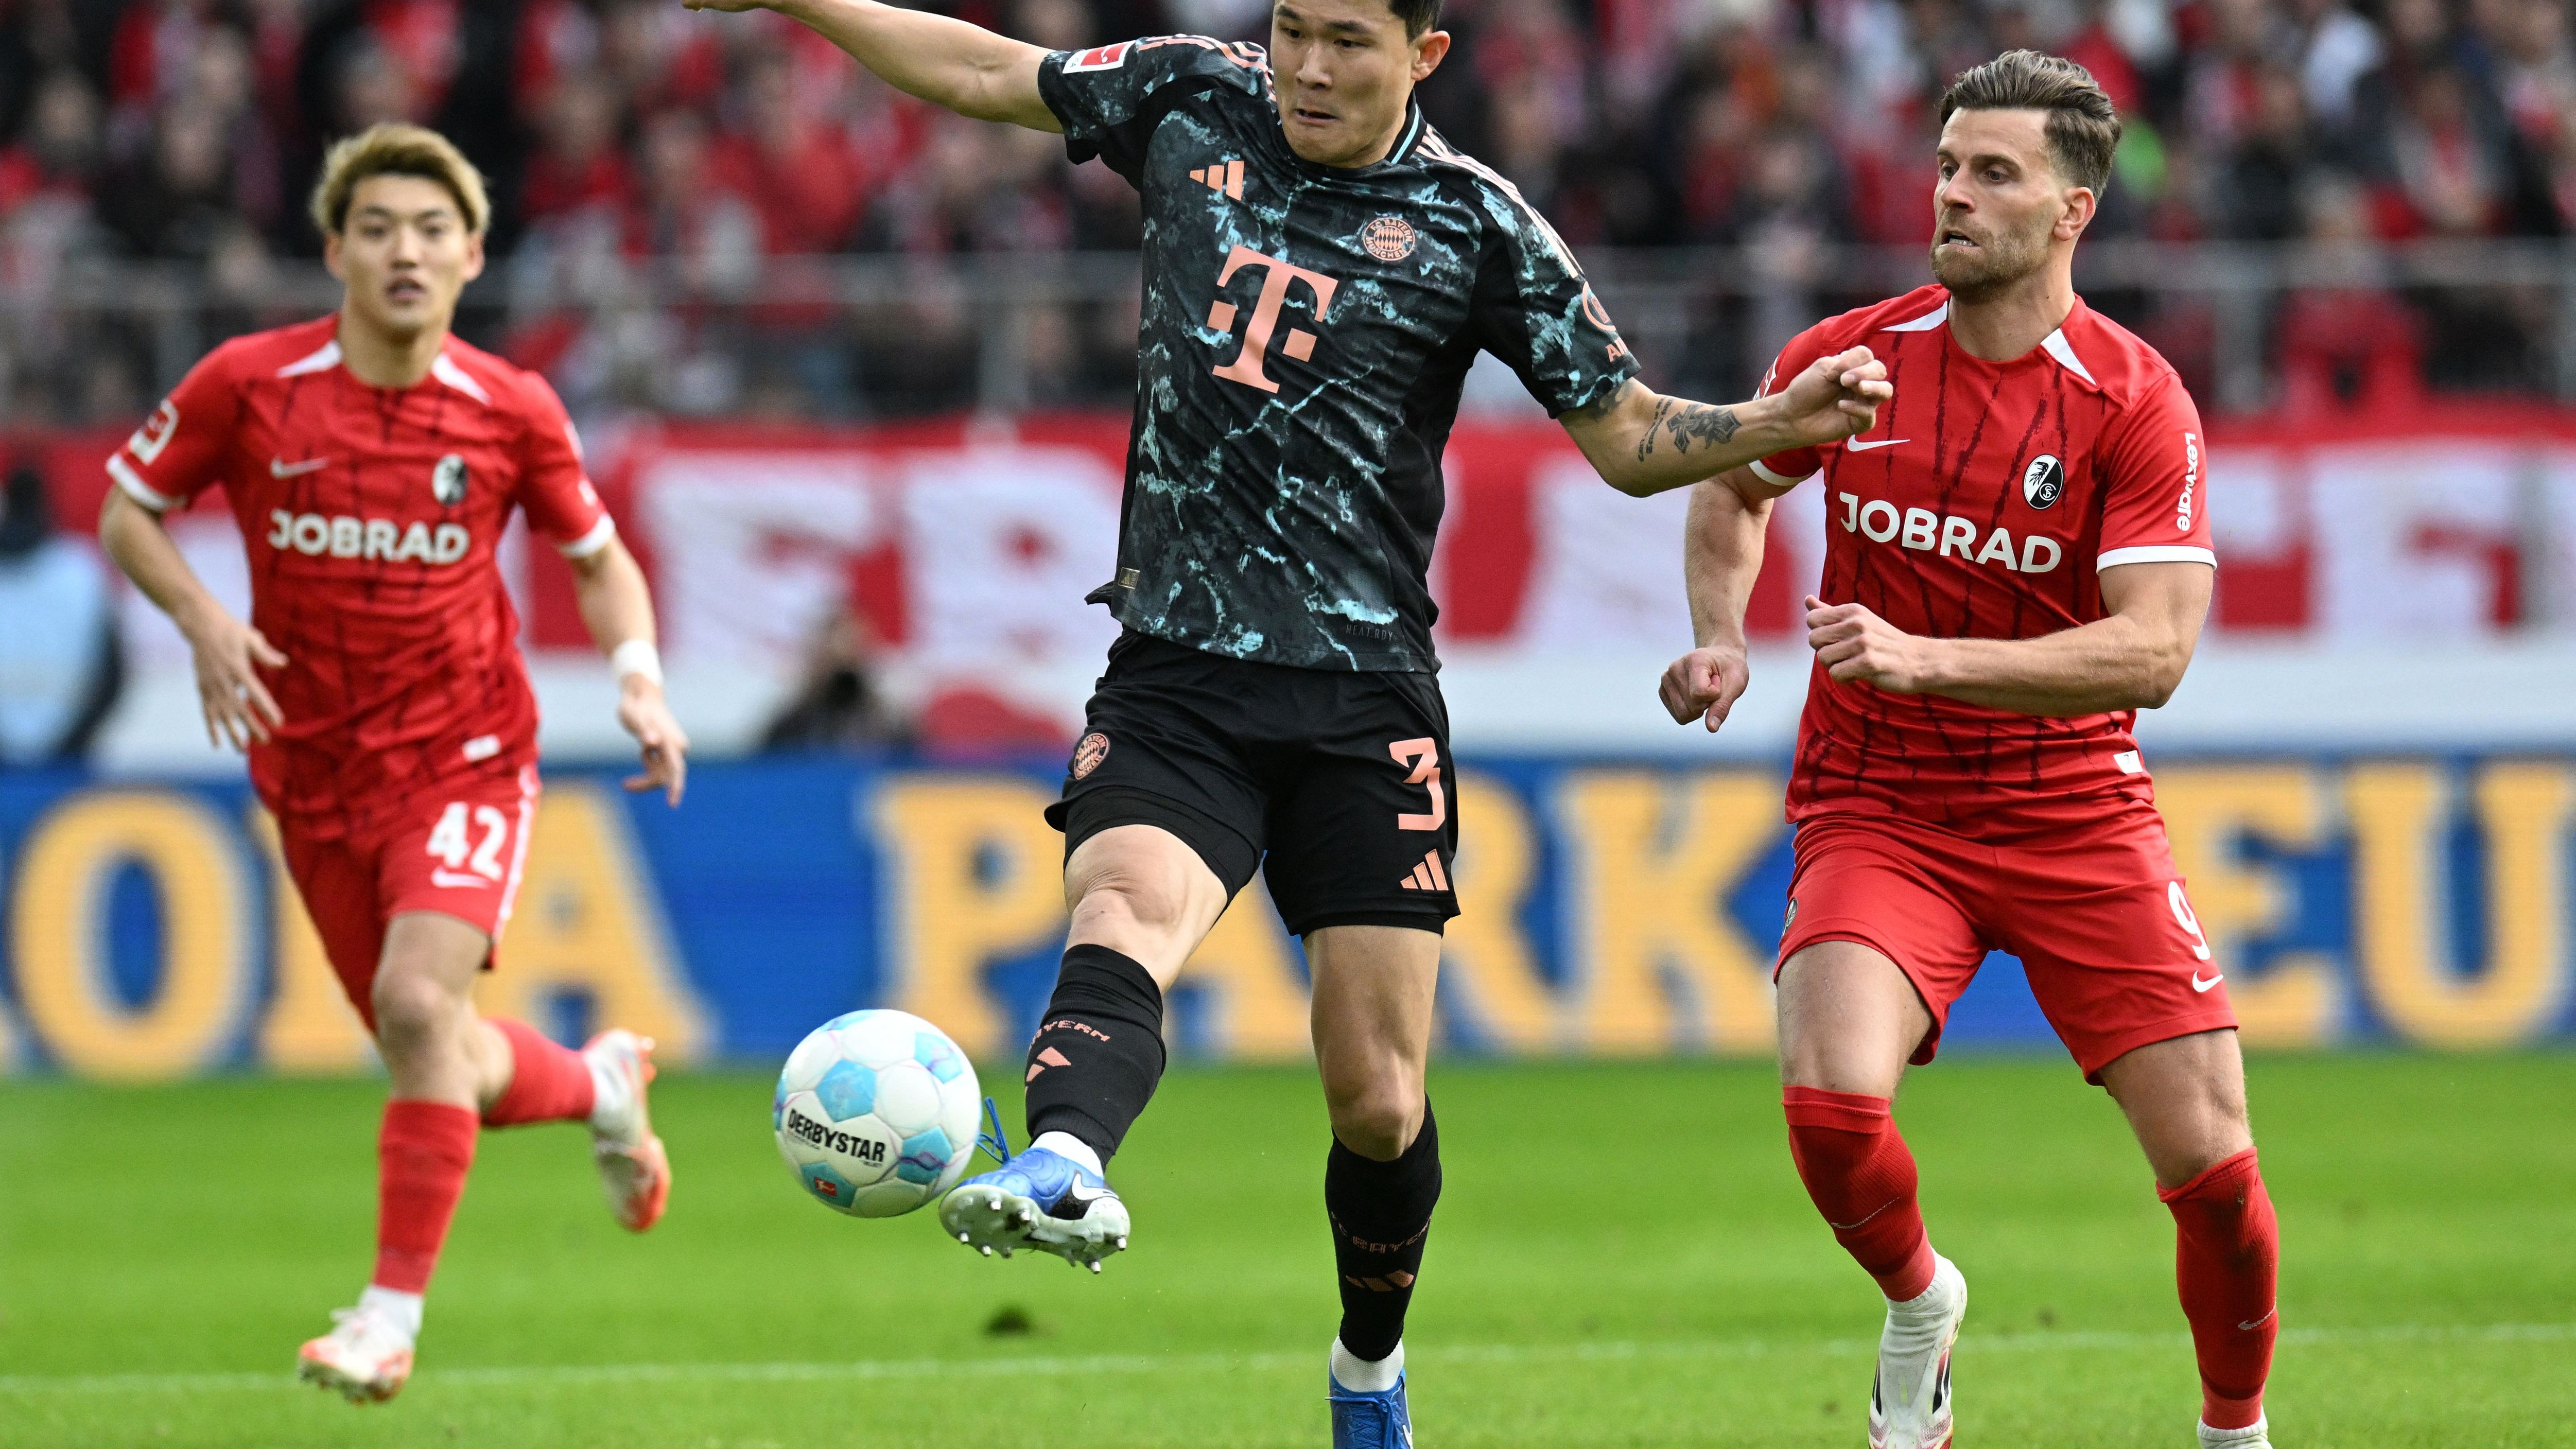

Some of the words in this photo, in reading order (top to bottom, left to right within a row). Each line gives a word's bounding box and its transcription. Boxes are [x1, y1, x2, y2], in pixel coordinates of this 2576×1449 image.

[1384, 219, 1413, 242] BAYERN
[1208, 245, 1338, 394] T
[2177, 432, 2198, 532] Lexware
[267, 508, 469, 565] JOBRAD
[1839, 491, 2062, 573] JOBRAD
[1346, 624, 1393, 642] HEAT.RDY
[1389, 737, 1445, 831] 3
[426, 801, 508, 882] 42
[2168, 881, 2211, 961] 9
[788, 1108, 886, 1162] DERBYSTAR
